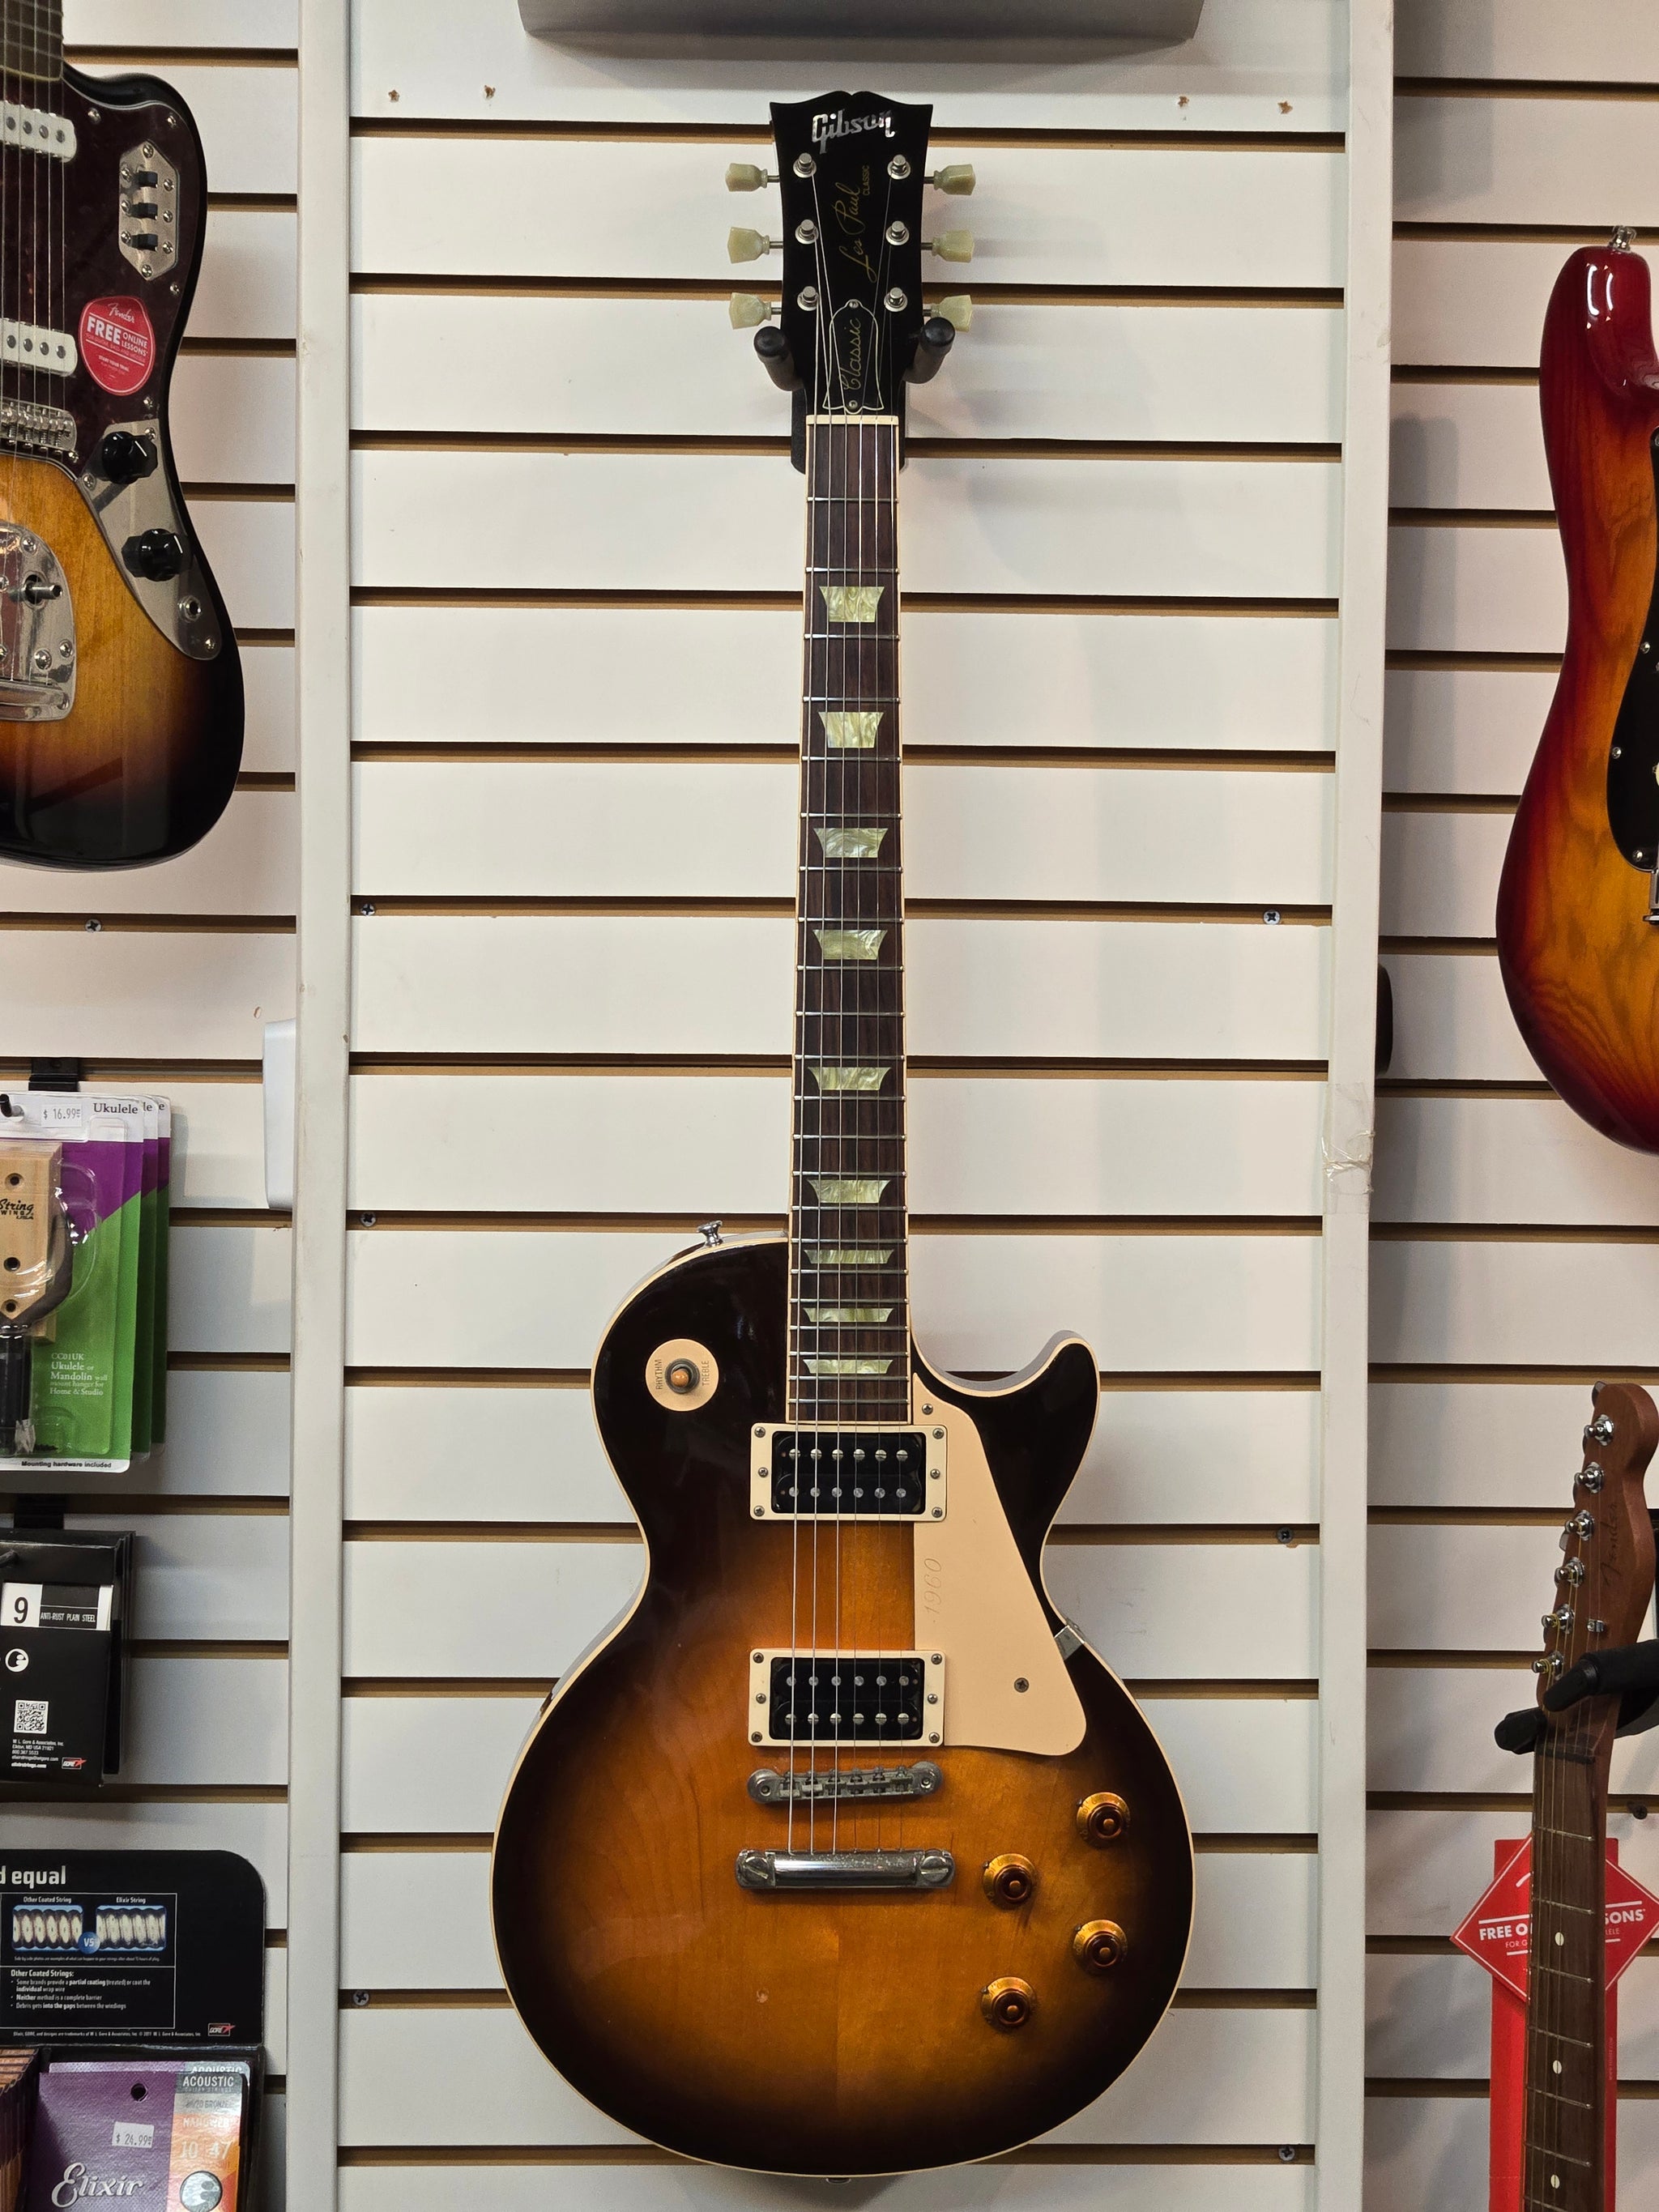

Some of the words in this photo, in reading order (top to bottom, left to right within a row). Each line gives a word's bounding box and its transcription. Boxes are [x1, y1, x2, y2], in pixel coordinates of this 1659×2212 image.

[812, 109, 895, 155] Gibson
[862, 164, 870, 195] CLASSIC
[831, 181, 866, 235] Paul
[838, 237, 877, 283] Les
[108, 302, 134, 324] Fender
[87, 315, 122, 345] FREE
[122, 332, 148, 348] ONLINE
[838, 318, 861, 390] Classic
[93, 1102, 139, 1115] Ukulele
[50, 1371, 92, 1381] Mandolin
[51, 1362, 85, 1370] Ukulele
[655, 1359, 663, 1390] RHYTHM
[702, 1361, 710, 1387] TREBLE
[81, 1387, 104, 1396] Studio
[923, 1558, 942, 1614] 1960
[13, 1596, 28, 1624] 9
[40, 1612, 65, 1621] ANTI-RUST
[66, 1613, 80, 1622] PLAIN
[82, 1614, 96, 1622] STEEL
[11, 1865, 66, 1889] equal
[56, 1896, 72, 1904] String
[130, 1896, 146, 1904] String
[83, 1937, 96, 1948] VS
[1479, 1924, 1512, 1941] FREE
[11, 1969, 28, 1977] Other
[28, 1969, 49, 1977] Coated
[50, 1969, 75, 1978] Strings:
[87, 1979, 106, 1987] coating
[182, 2076, 235, 2087] ACOUSTIC
[51, 2162, 143, 2208] Elixir
